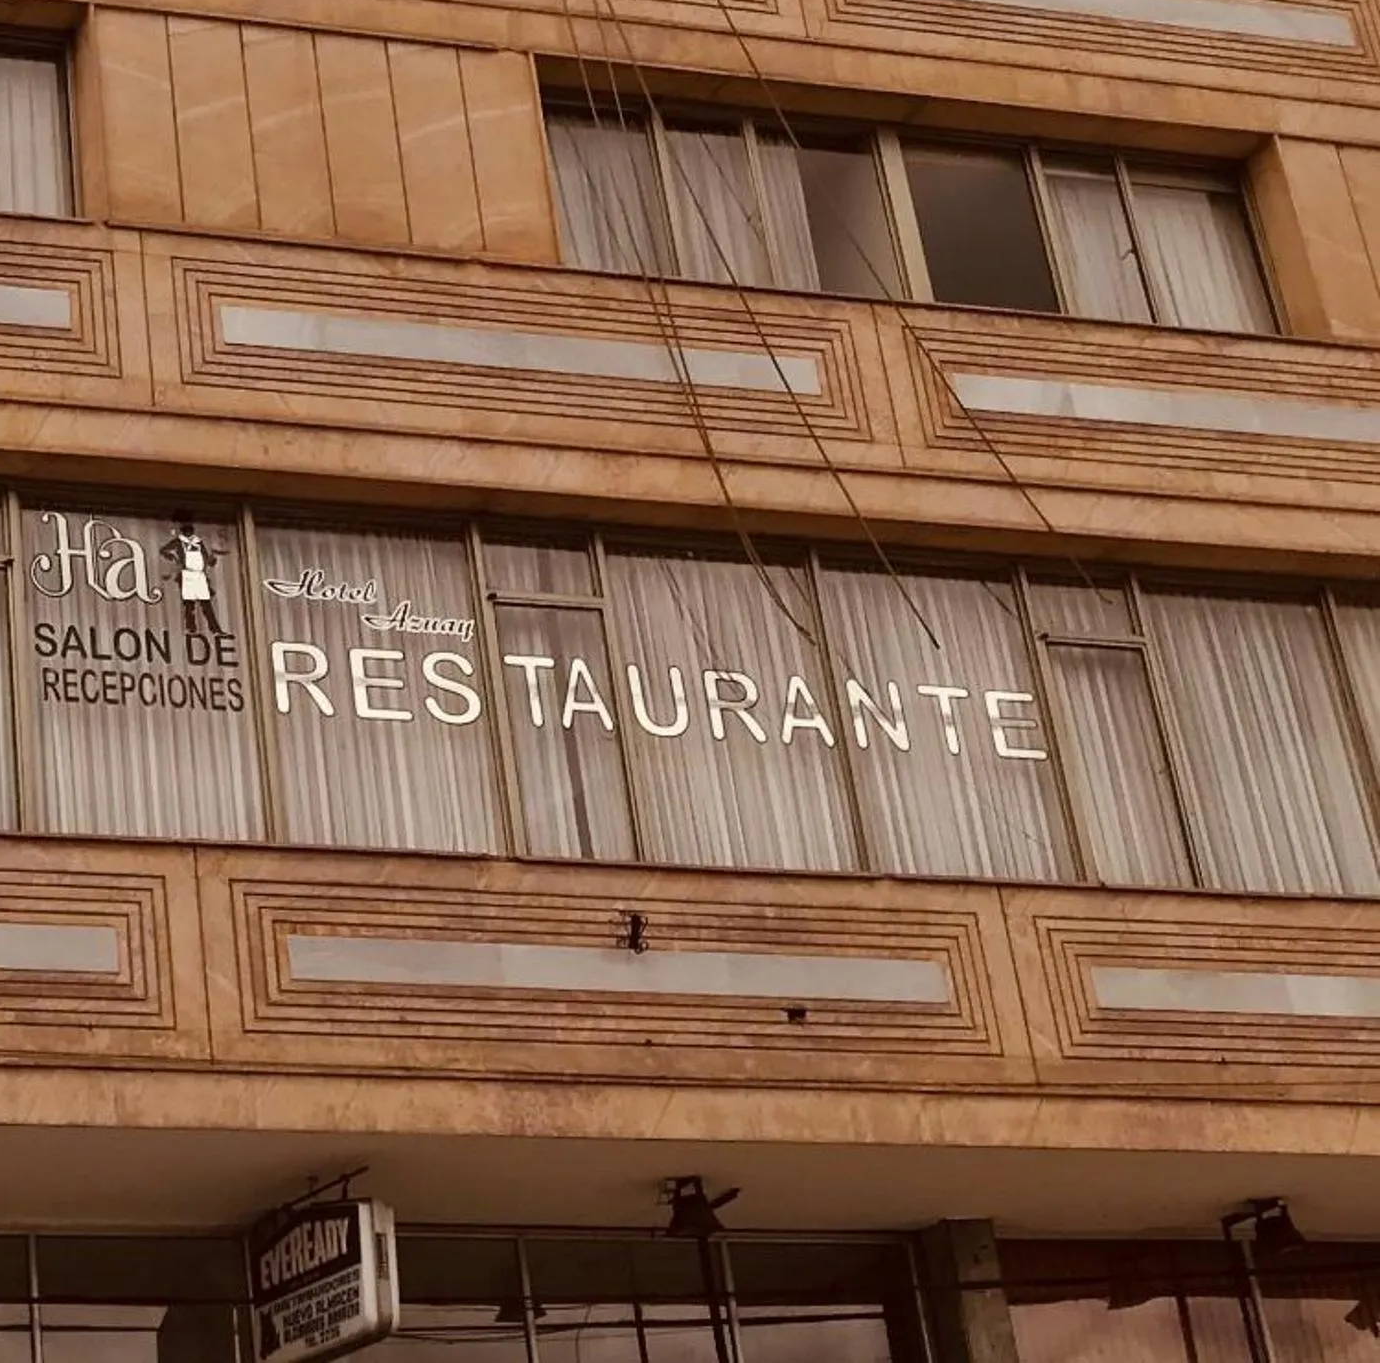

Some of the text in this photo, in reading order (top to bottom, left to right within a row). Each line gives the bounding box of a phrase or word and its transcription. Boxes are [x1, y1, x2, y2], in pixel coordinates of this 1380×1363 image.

[263, 569, 377, 603] Hotel
[361, 600, 474, 642] Azuay
[34, 623, 240, 668] SALON DE
[42, 668, 245, 712] RECEPCIONES
[271, 641, 1048, 760] RESTAURANTE
[260, 1216, 349, 1290] EVEREADY
